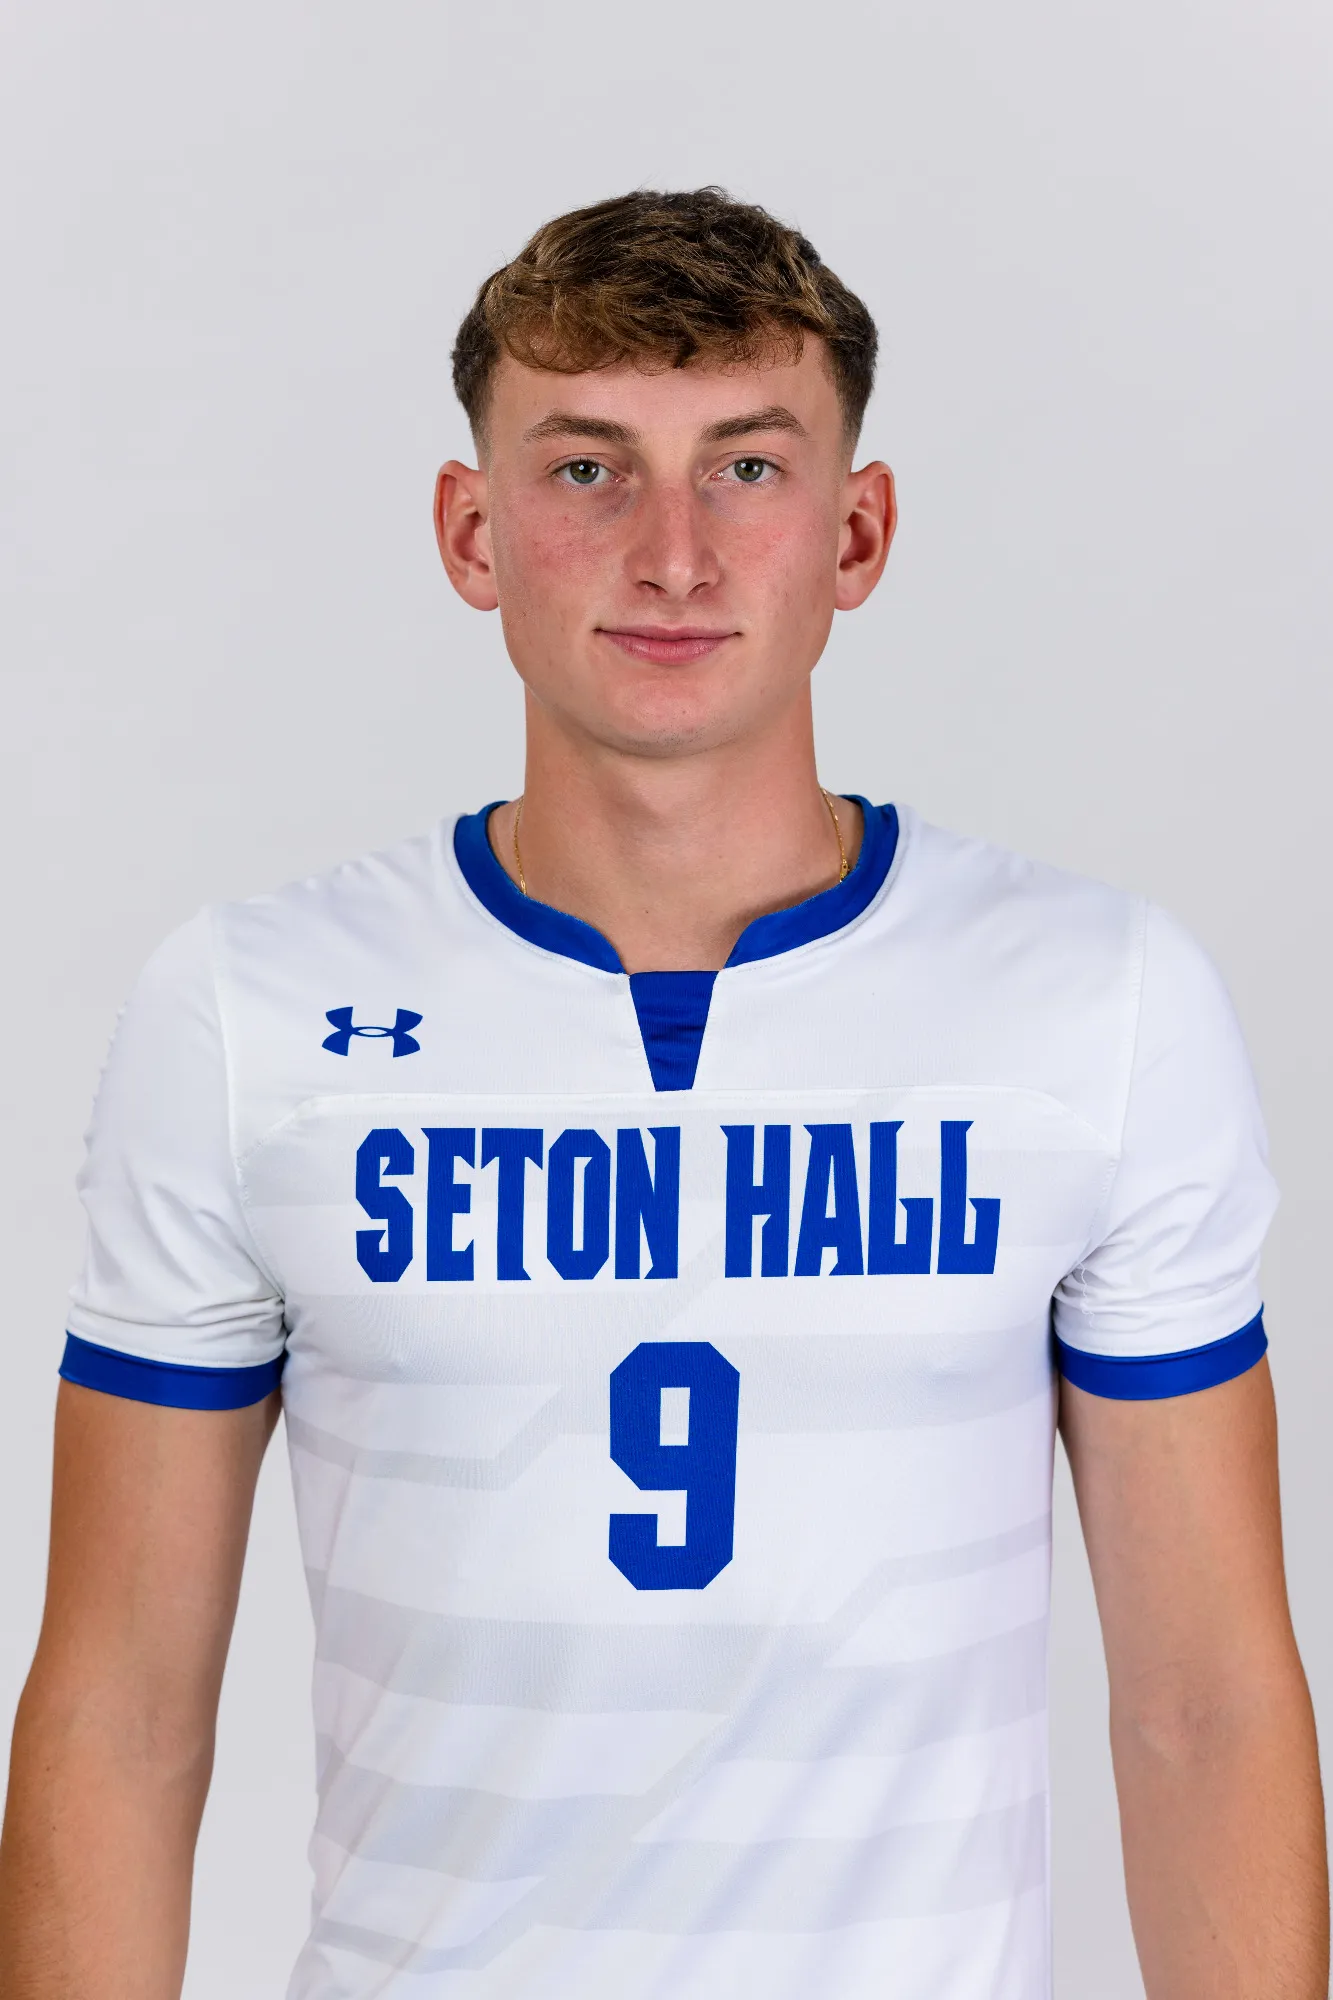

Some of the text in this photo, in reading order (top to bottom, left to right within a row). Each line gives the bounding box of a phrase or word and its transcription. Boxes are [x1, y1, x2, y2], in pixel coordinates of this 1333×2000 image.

[356, 1120, 1001, 1282] SETON HALL
[608, 1342, 740, 1590] 9
